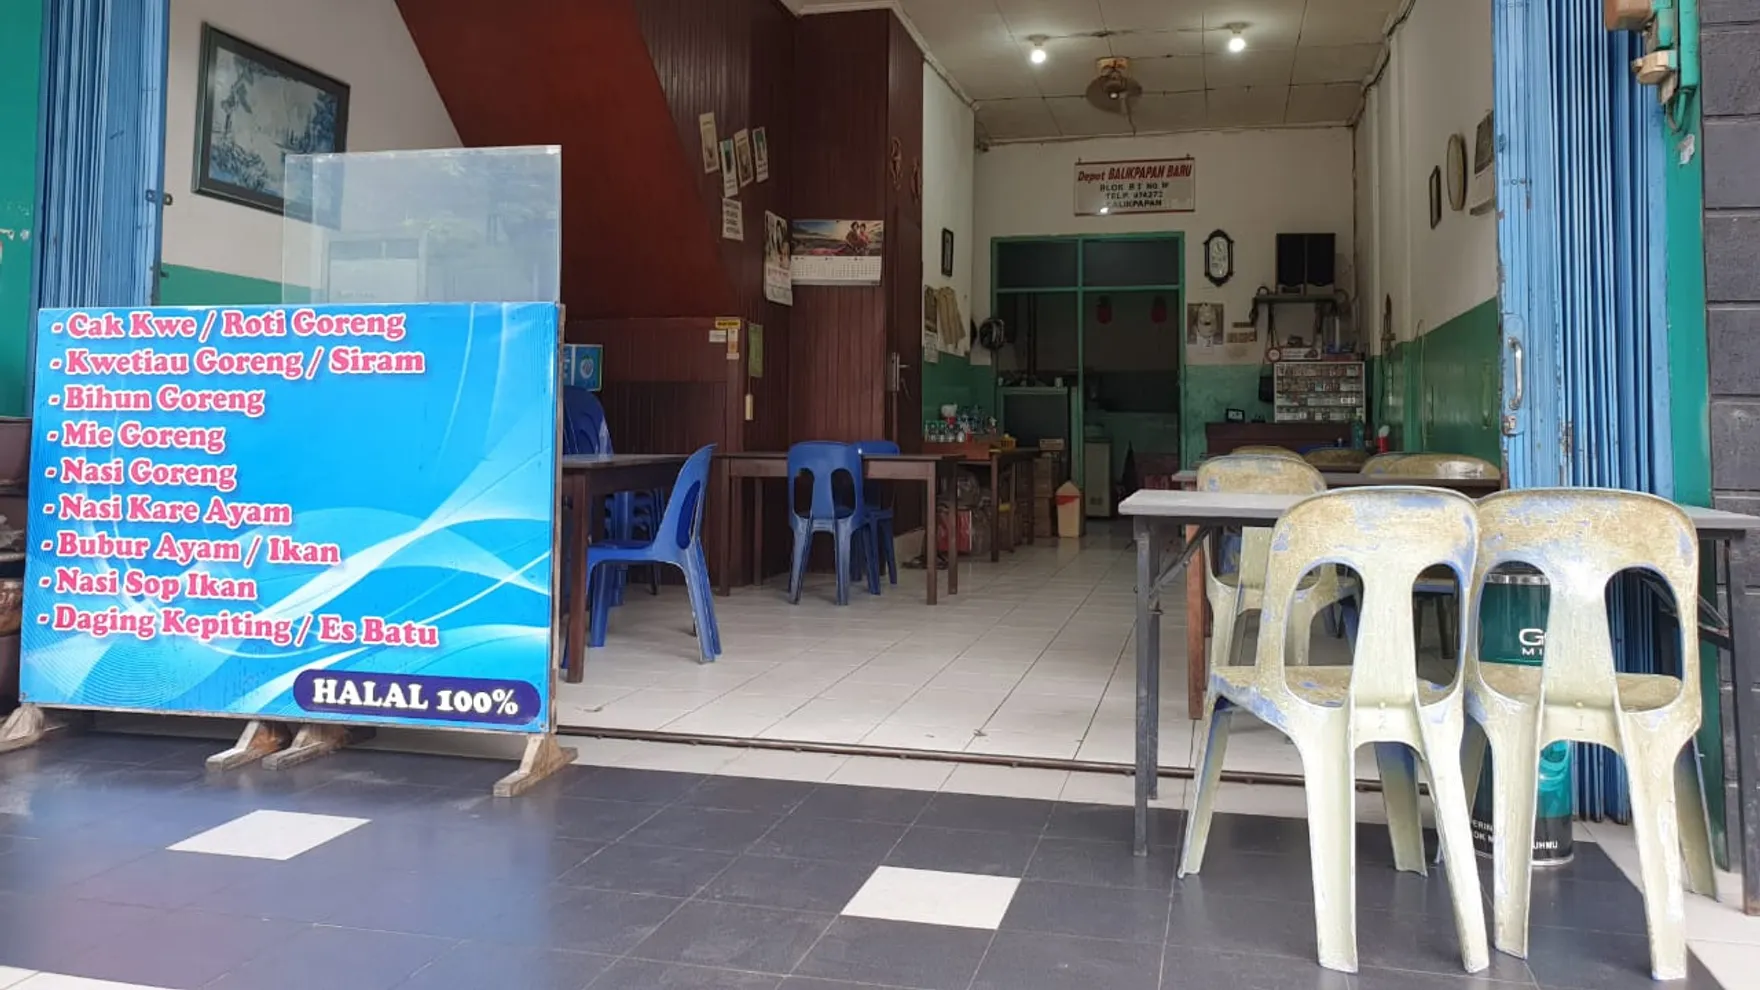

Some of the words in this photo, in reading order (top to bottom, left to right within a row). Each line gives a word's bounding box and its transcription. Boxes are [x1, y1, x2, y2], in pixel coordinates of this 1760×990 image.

[1078, 171, 1105, 183] Depot
[1108, 165, 1165, 180] BALIKPAPAN
[1166, 164, 1192, 177] BARU
[68, 314, 123, 337] Cak
[131, 313, 196, 336] Kwe
[223, 310, 285, 336] Roti
[293, 310, 404, 340] Goreng
[67, 350, 188, 374] Kwetiau
[195, 349, 302, 378] Goreng
[331, 348, 424, 373] Siram
[65, 387, 151, 411] Bihun
[158, 386, 263, 416] Goreng
[63, 422, 113, 446] Mie
[119, 422, 224, 452] Goreng
[62, 458, 123, 483] Nasi
[130, 459, 235, 490] Goreng
[60, 495, 121, 520] Nasi
[129, 496, 198, 521] Kare
[205, 498, 291, 527] Ayam
[57, 531, 149, 558] Bubur
[156, 534, 240, 564] Ayam
[269, 537, 340, 564] Ikan
[56, 568, 118, 594] Nasi
[125, 570, 180, 601] Sop
[187, 572, 256, 599] Ikan
[54, 605, 155, 638] Daging
[162, 609, 291, 645] Kepiting
[320, 615, 355, 642] Es
[363, 618, 438, 646] Batu
[1519, 628, 1546, 646] G
[312, 678, 429, 710] HALAL
[436, 688, 519, 715] 100%
